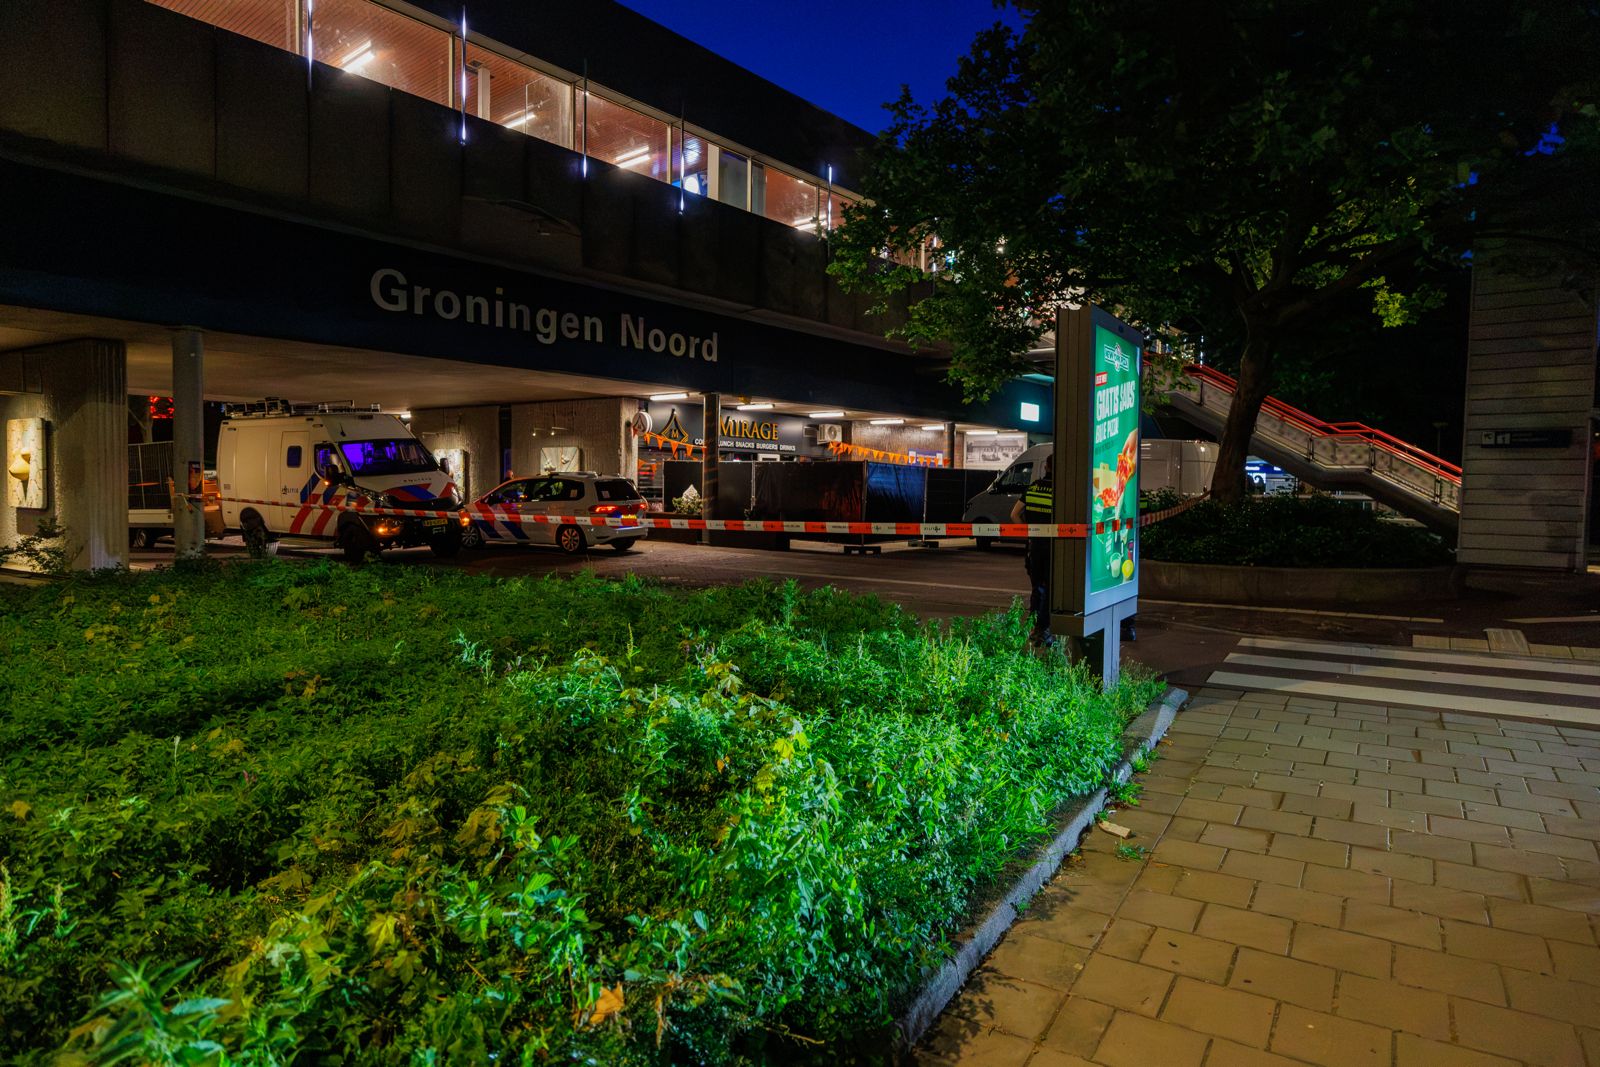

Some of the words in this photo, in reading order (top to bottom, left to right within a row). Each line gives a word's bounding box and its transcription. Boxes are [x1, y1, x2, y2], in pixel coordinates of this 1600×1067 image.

[370, 268, 602, 344] Groningen
[620, 313, 718, 362] Noord
[719, 414, 778, 440] MIRAGE
[735, 441, 755, 449] SNACKS
